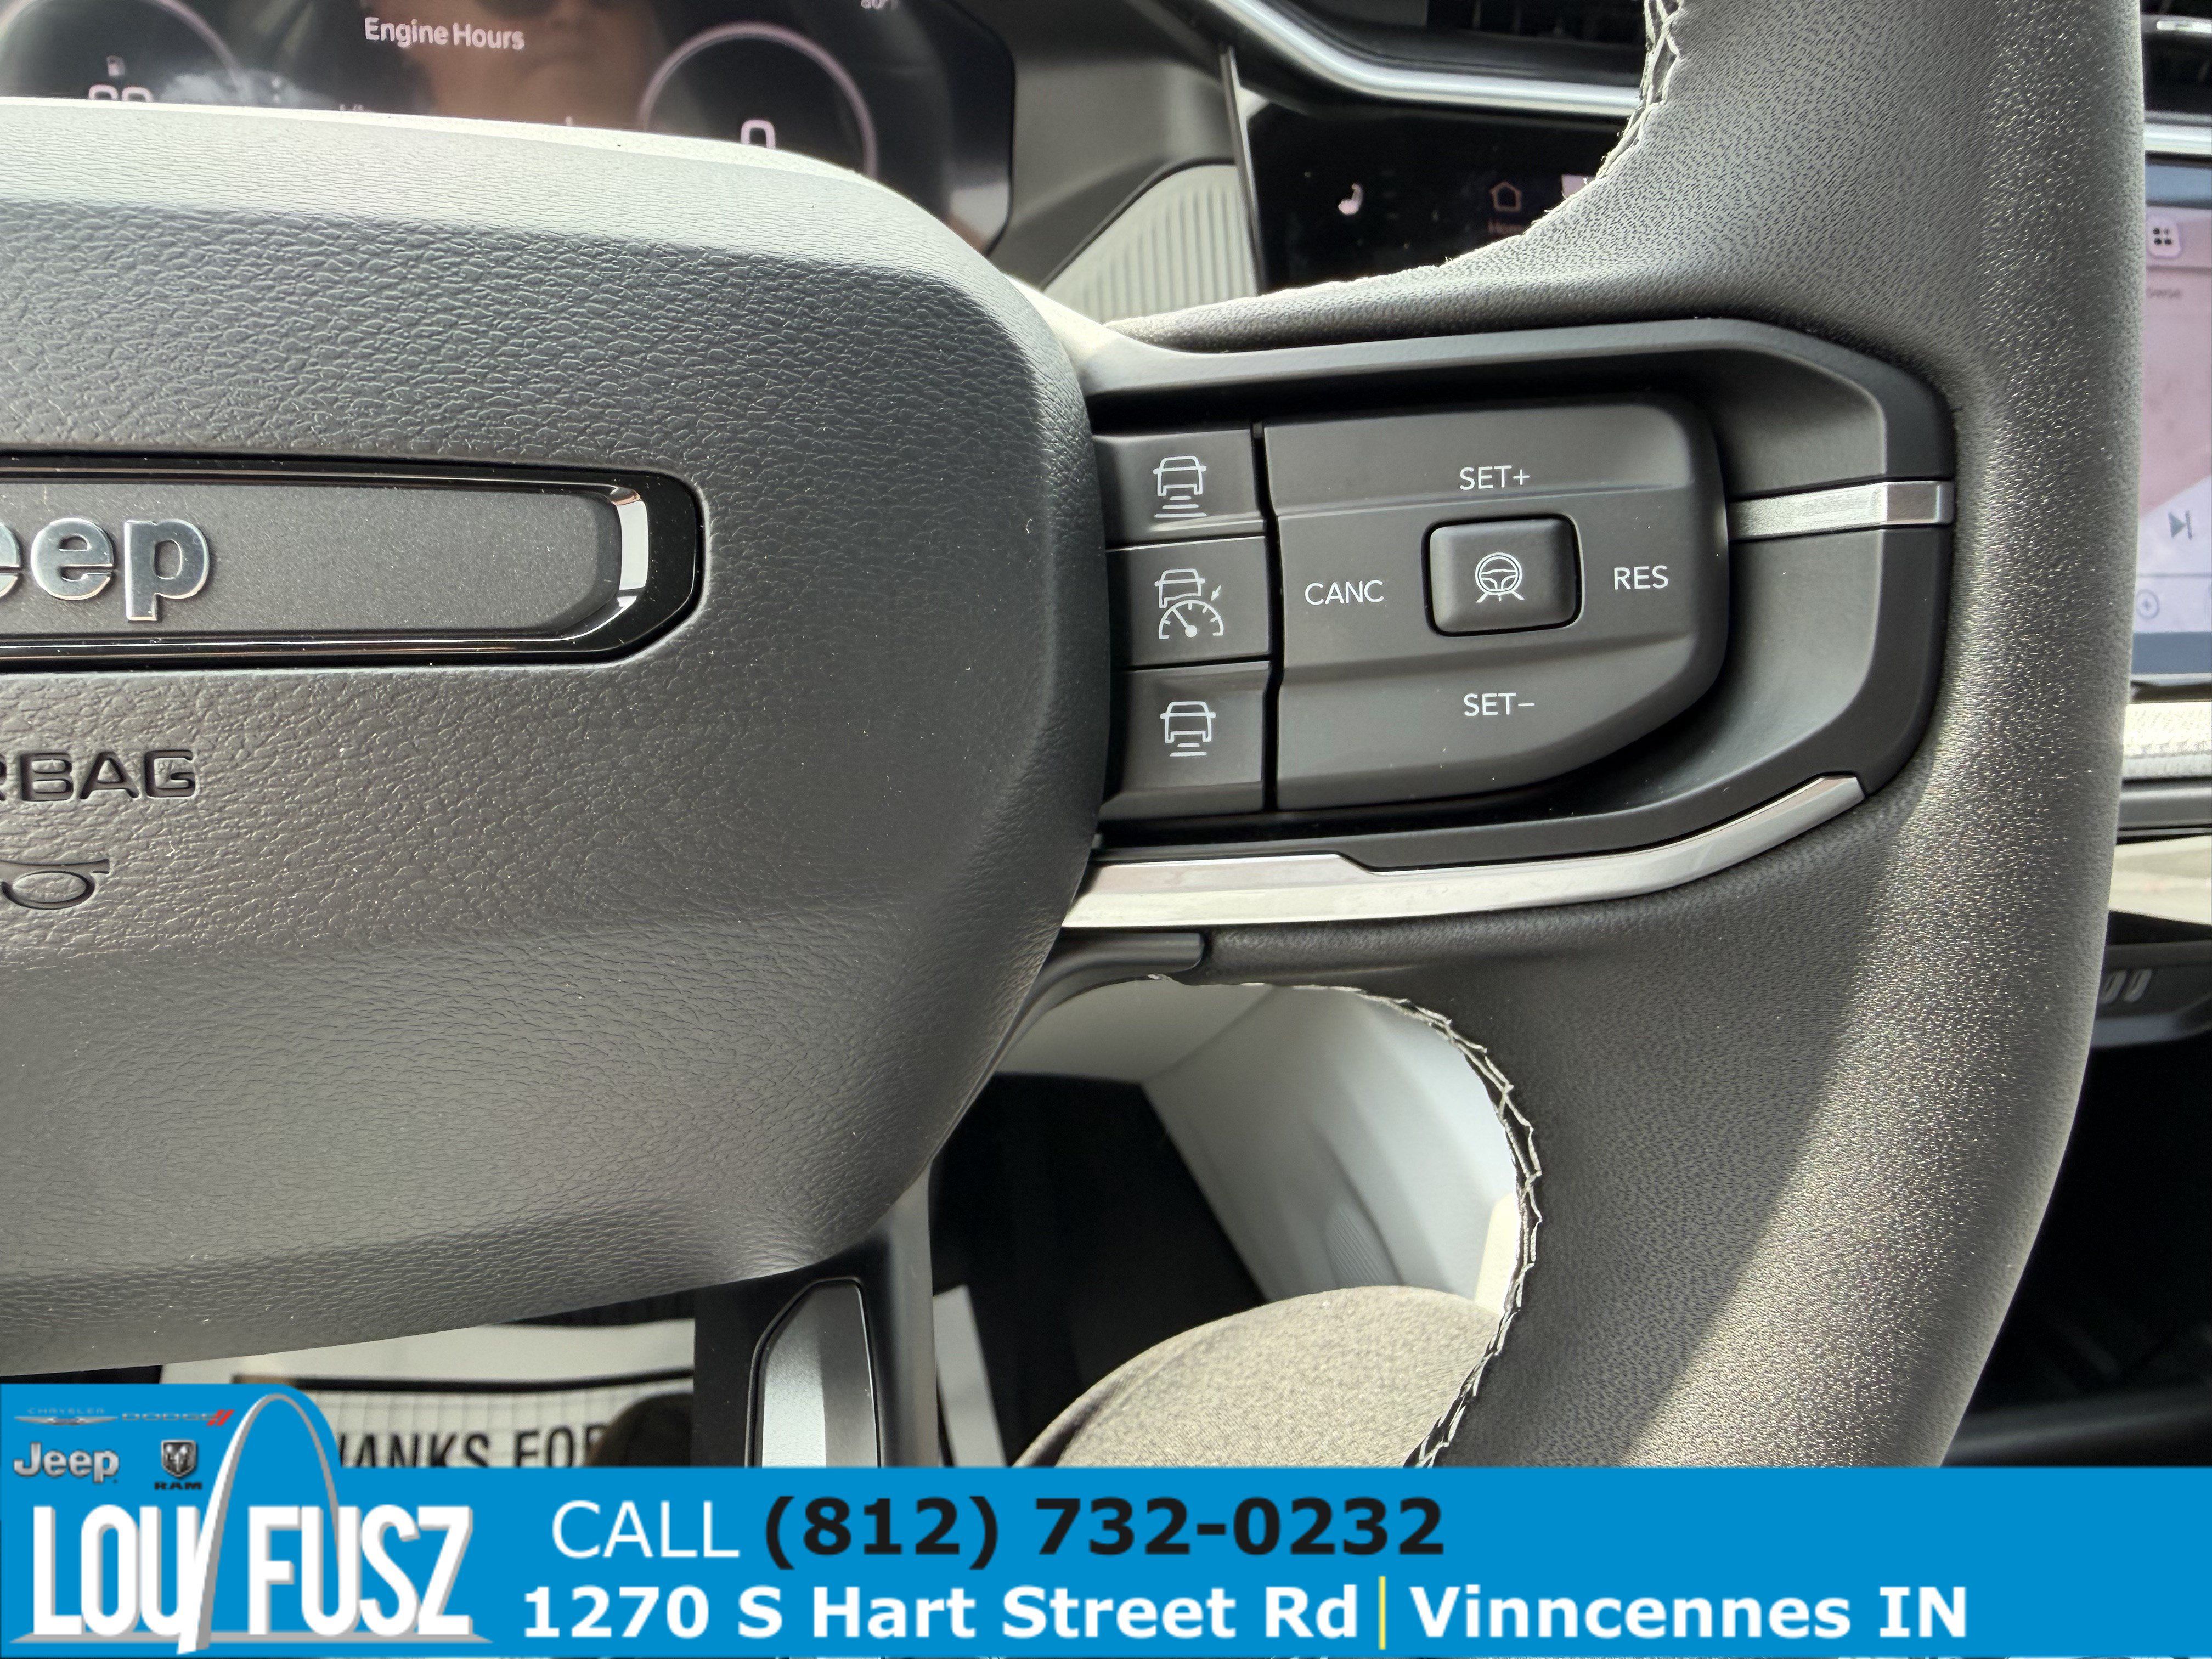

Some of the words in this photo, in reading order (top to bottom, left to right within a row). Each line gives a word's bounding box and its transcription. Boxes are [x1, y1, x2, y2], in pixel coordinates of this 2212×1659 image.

[364, 16, 448, 48] Engine
[453, 22, 525, 50] Hours
[1459, 465, 1530, 490] SET+
[1613, 565, 1669, 590] RES
[1305, 579, 1385, 606] CANC
[0, 750, 196, 802] BAG
